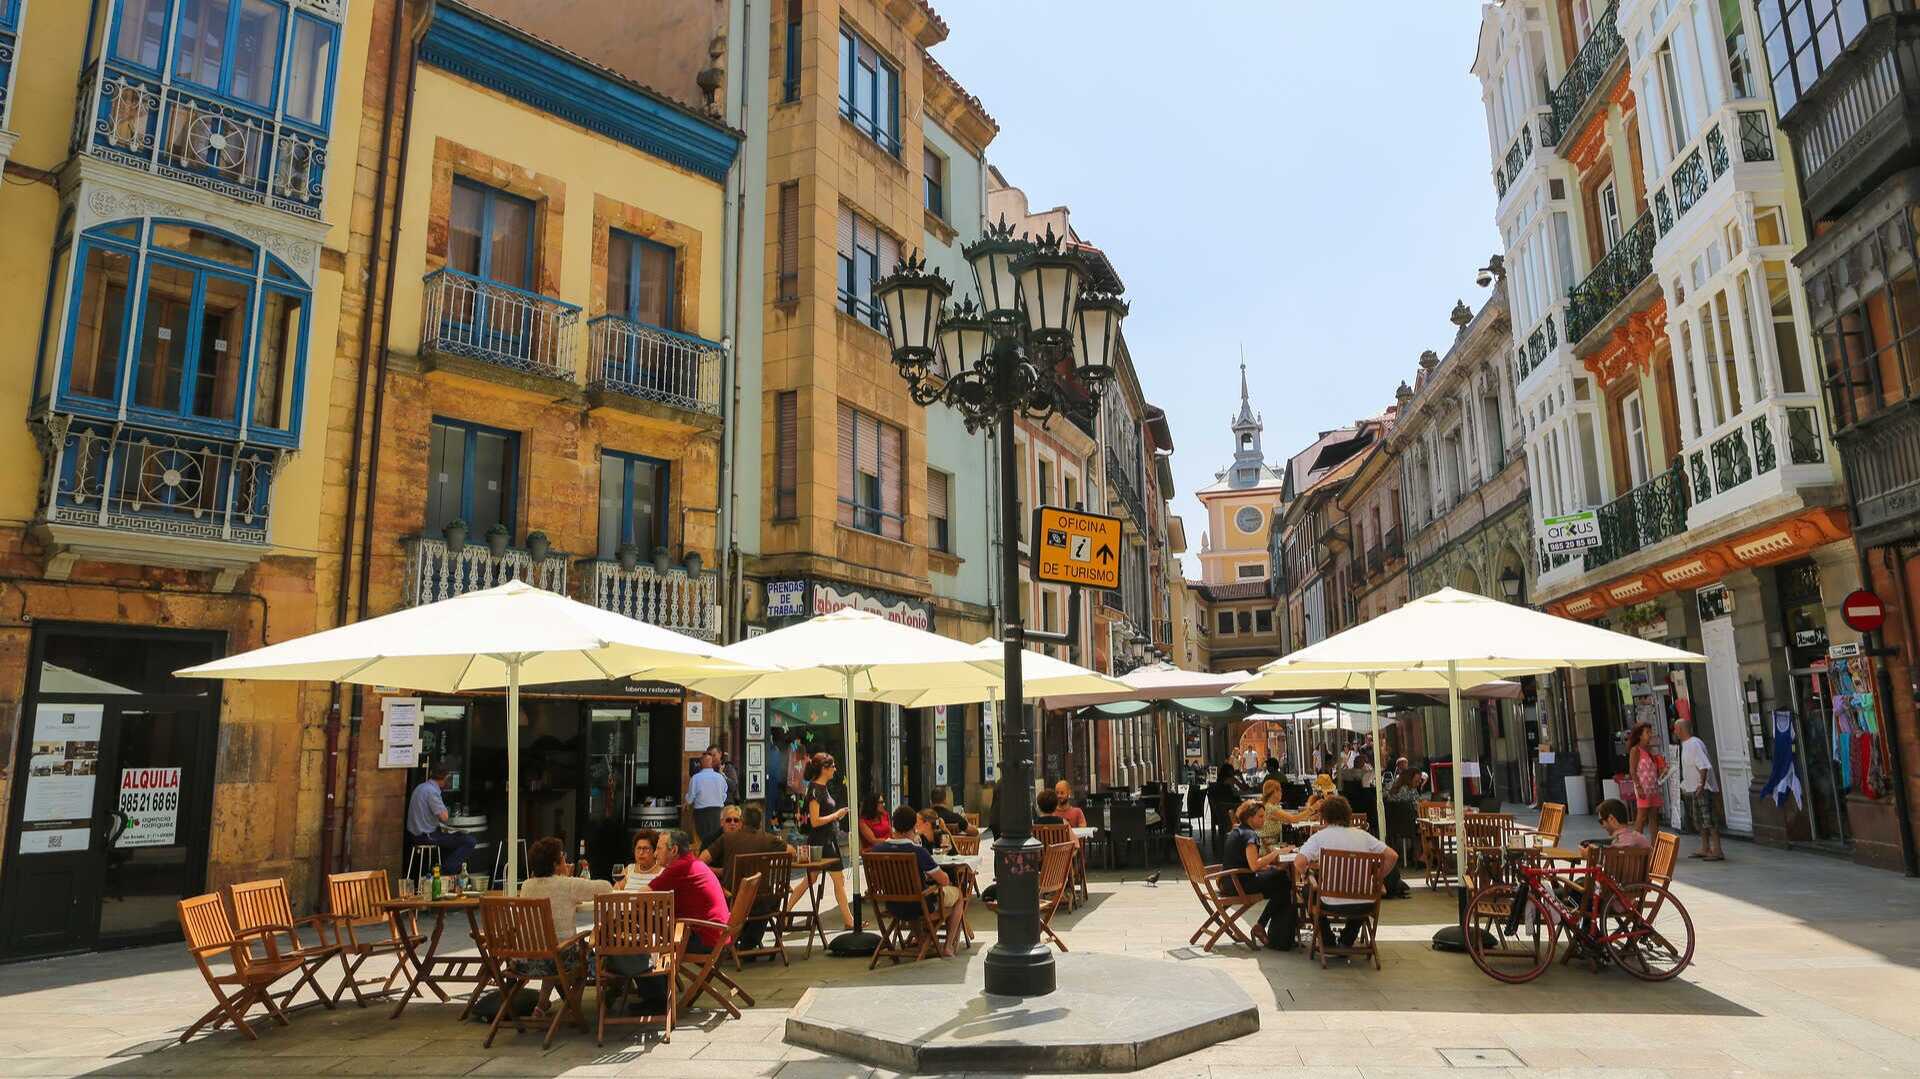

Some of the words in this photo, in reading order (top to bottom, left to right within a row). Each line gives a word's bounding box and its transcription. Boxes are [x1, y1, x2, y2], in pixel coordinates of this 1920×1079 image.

[1058, 516, 1107, 534] OFICINA
[1043, 561, 1060, 575] DE
[1063, 564, 1115, 583] TURISMO
[768, 581, 804, 594] PRENDAS
[780, 593, 791, 604] DE
[768, 604, 804, 616] TRABAJO
[122, 769, 178, 789] ALQUILA
[121, 793, 139, 813] 985
[140, 793, 151, 812] 21
[152, 792, 165, 811] 68
[165, 791, 177, 811] 69
